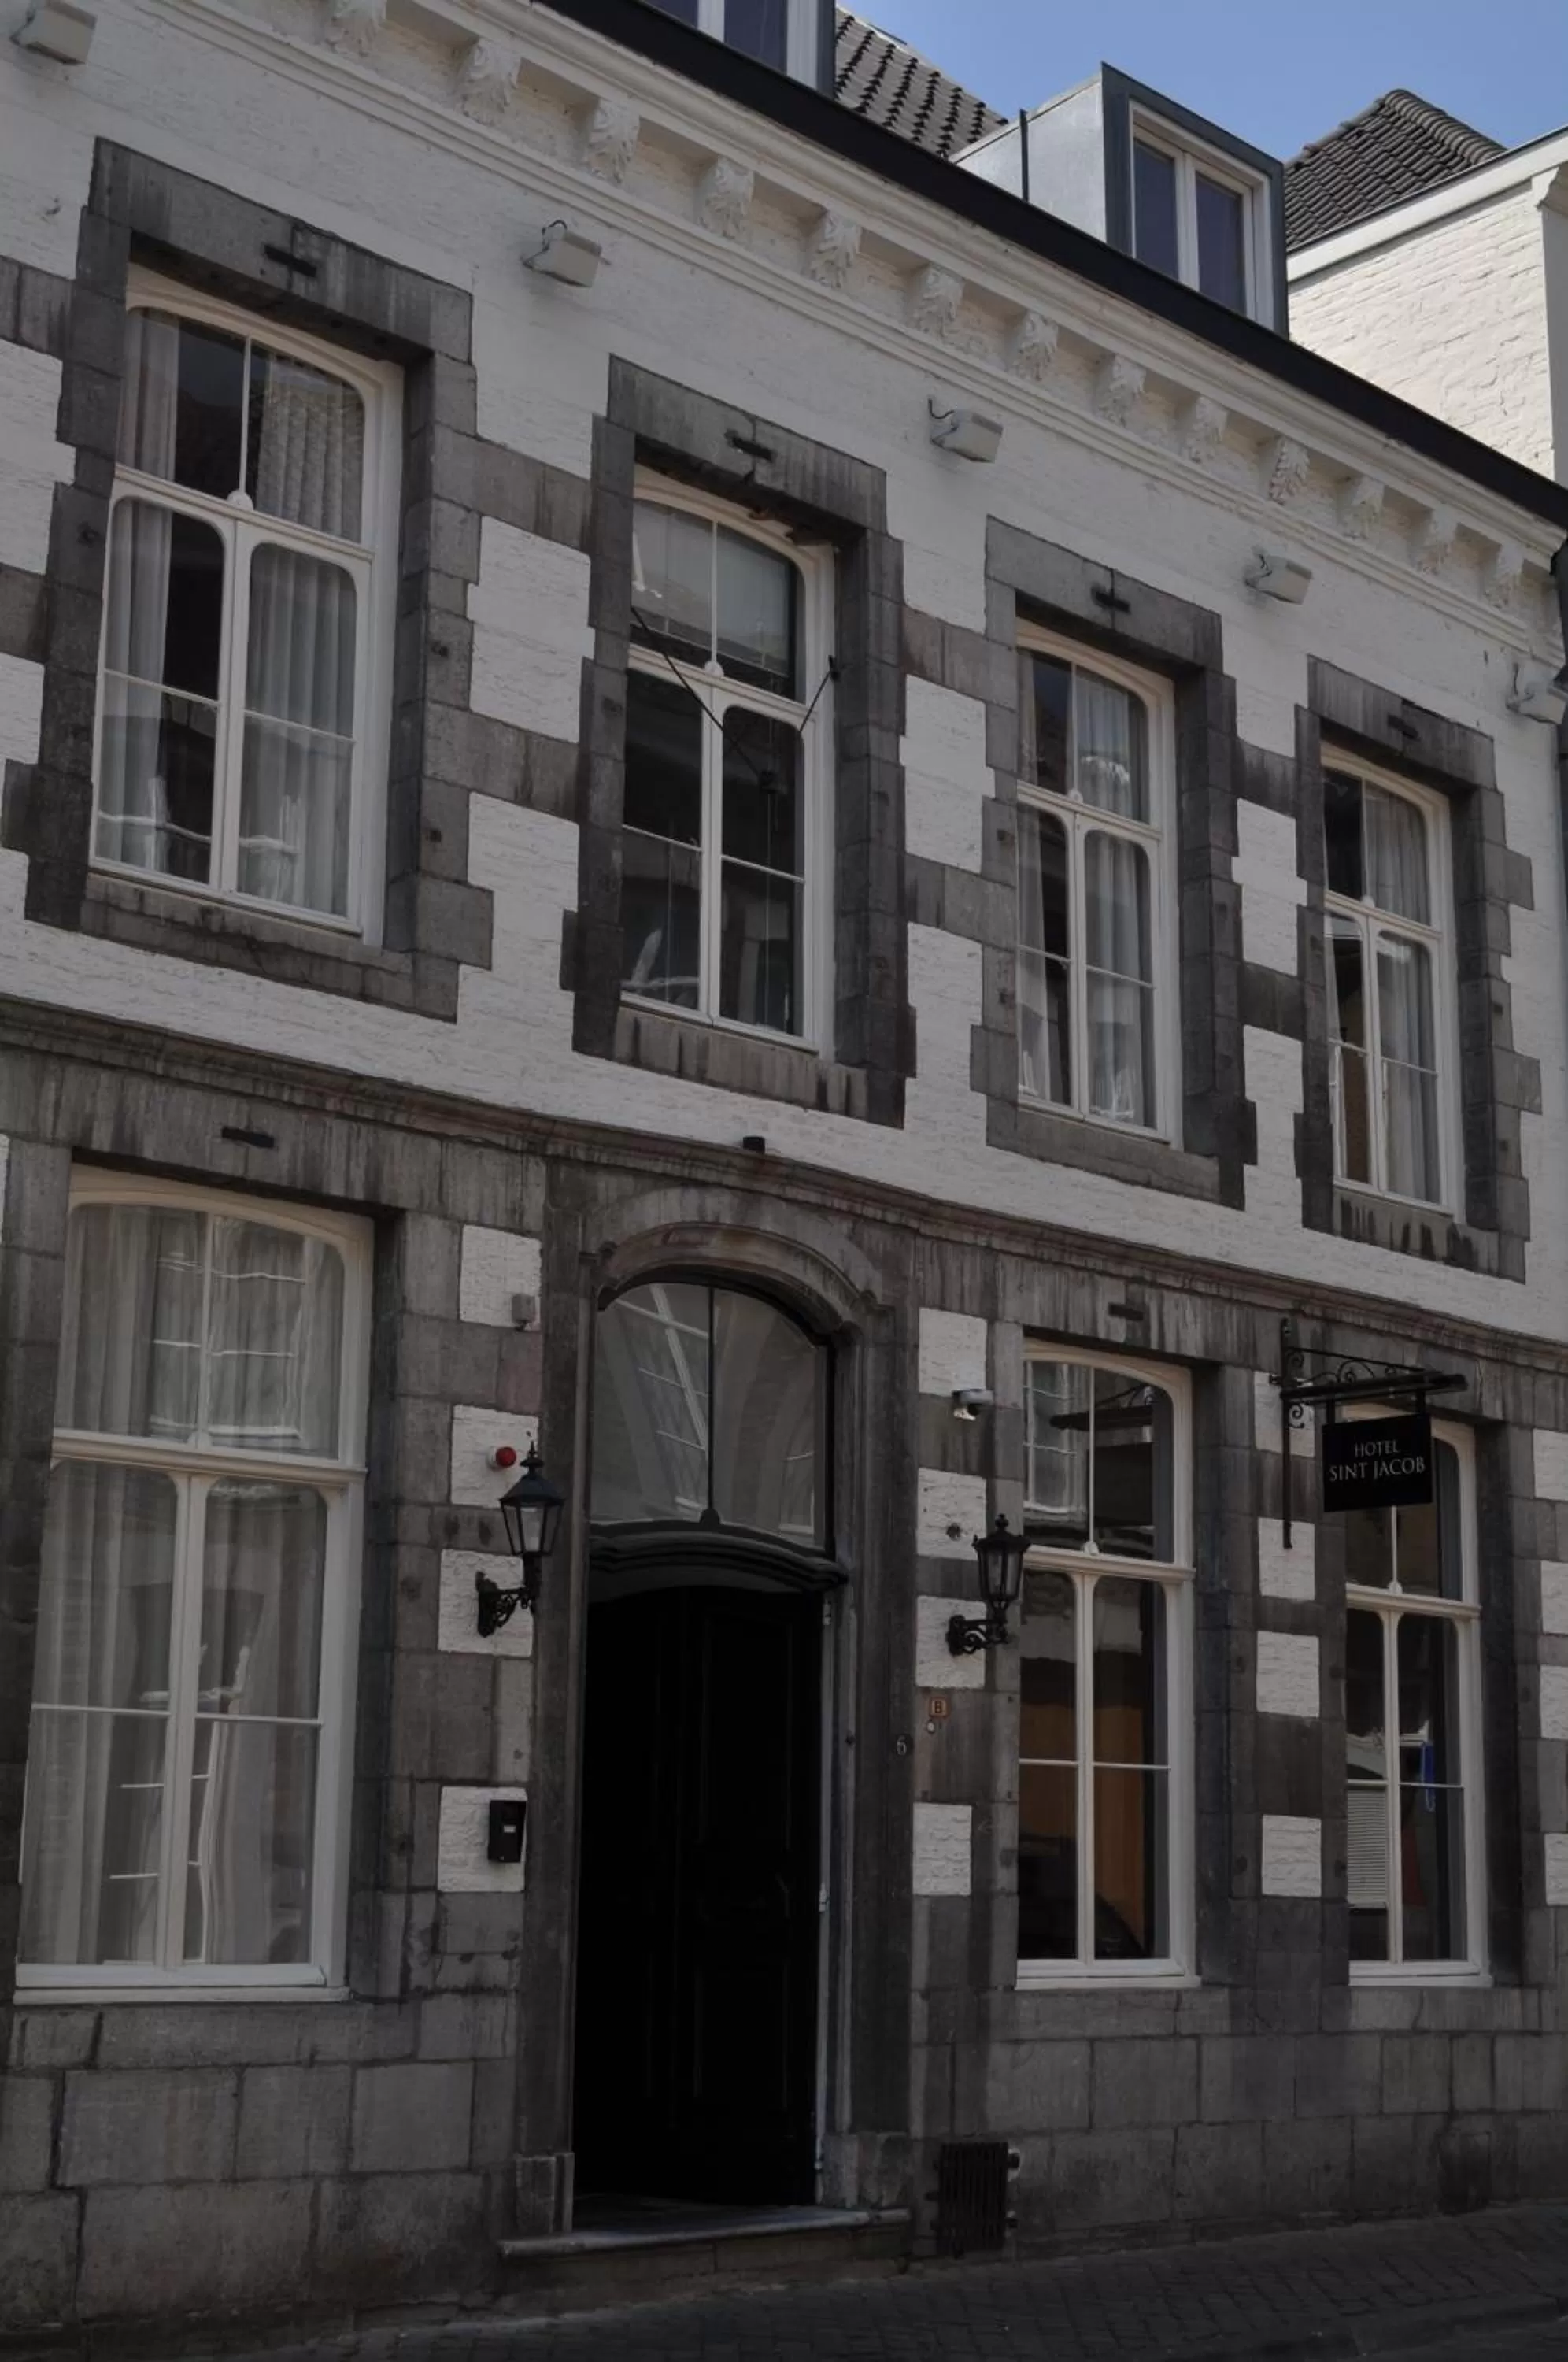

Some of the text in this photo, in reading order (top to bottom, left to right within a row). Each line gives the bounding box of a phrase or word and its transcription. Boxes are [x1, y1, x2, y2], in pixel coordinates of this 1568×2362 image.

[1354, 1439, 1401, 1458] HOTEL
[1329, 1455, 1426, 1483] SINT JACOB
[897, 1734, 907, 1756] 6
